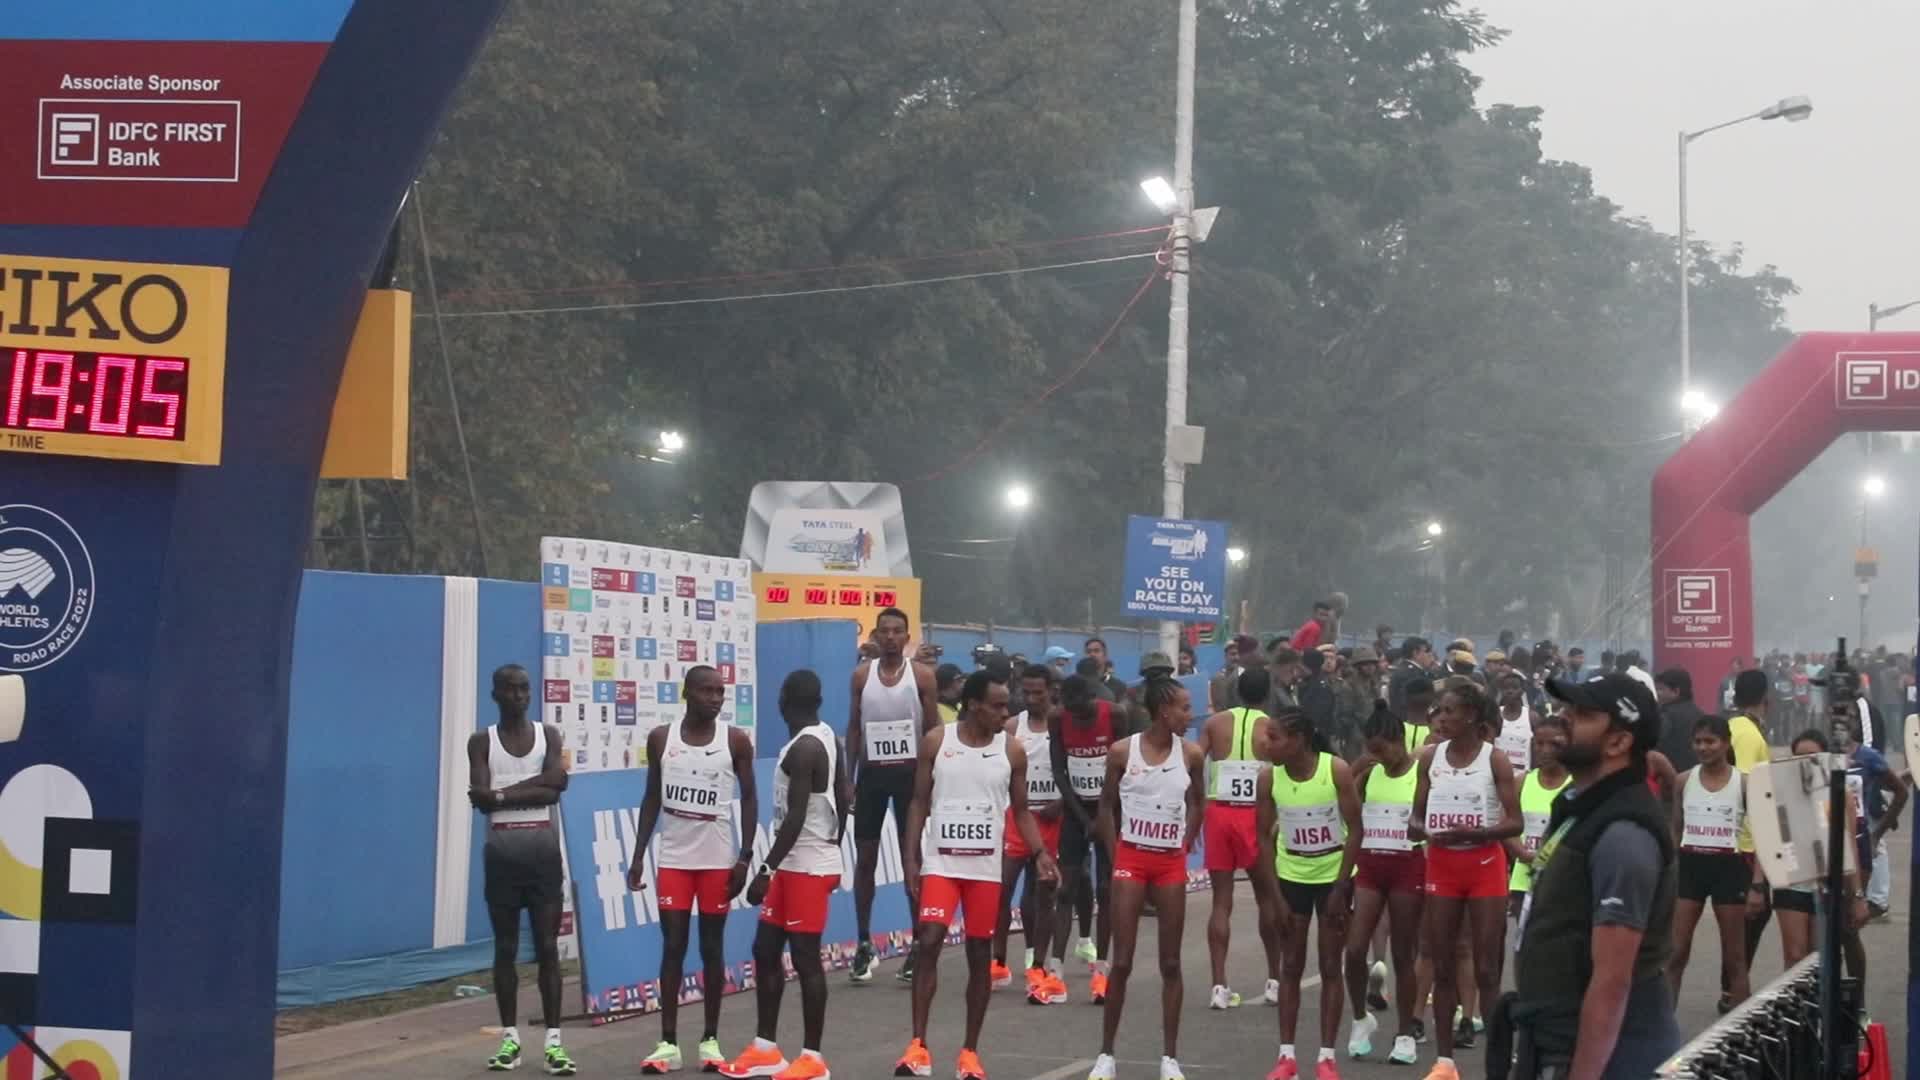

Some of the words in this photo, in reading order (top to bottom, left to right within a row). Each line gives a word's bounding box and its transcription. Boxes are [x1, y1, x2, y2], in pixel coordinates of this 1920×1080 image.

[60, 74, 143, 90] Associate
[148, 75, 220, 94] Sponsor
[108, 122, 158, 142] IDFC
[164, 123, 226, 142] FIRST
[108, 147, 160, 167] Bank
[0, 268, 188, 344] IKO
[8, 434, 45, 449] TIME
[802, 520, 828, 529] TATA
[1160, 565, 1189, 578] SEE
[1144, 577, 1177, 591] YOU
[1180, 580, 1204, 593] ON
[1135, 589, 1176, 604] RACE
[1180, 592, 1213, 606] DAY
[1148, 602, 1195, 613] December
[13, 648, 47, 664] ROAD
[48, 625, 77, 653] RACE
[71, 588, 88, 624] 2022
[874, 739, 909, 756] TOLA
[1068, 746, 1108, 757] KENYA
[665, 783, 717, 806] VICTOR
[1231, 779, 1254, 797] 53
[941, 823, 992, 840] LEGESE
[1129, 818, 1179, 840] YIMER
[1292, 825, 1332, 845] JISA
